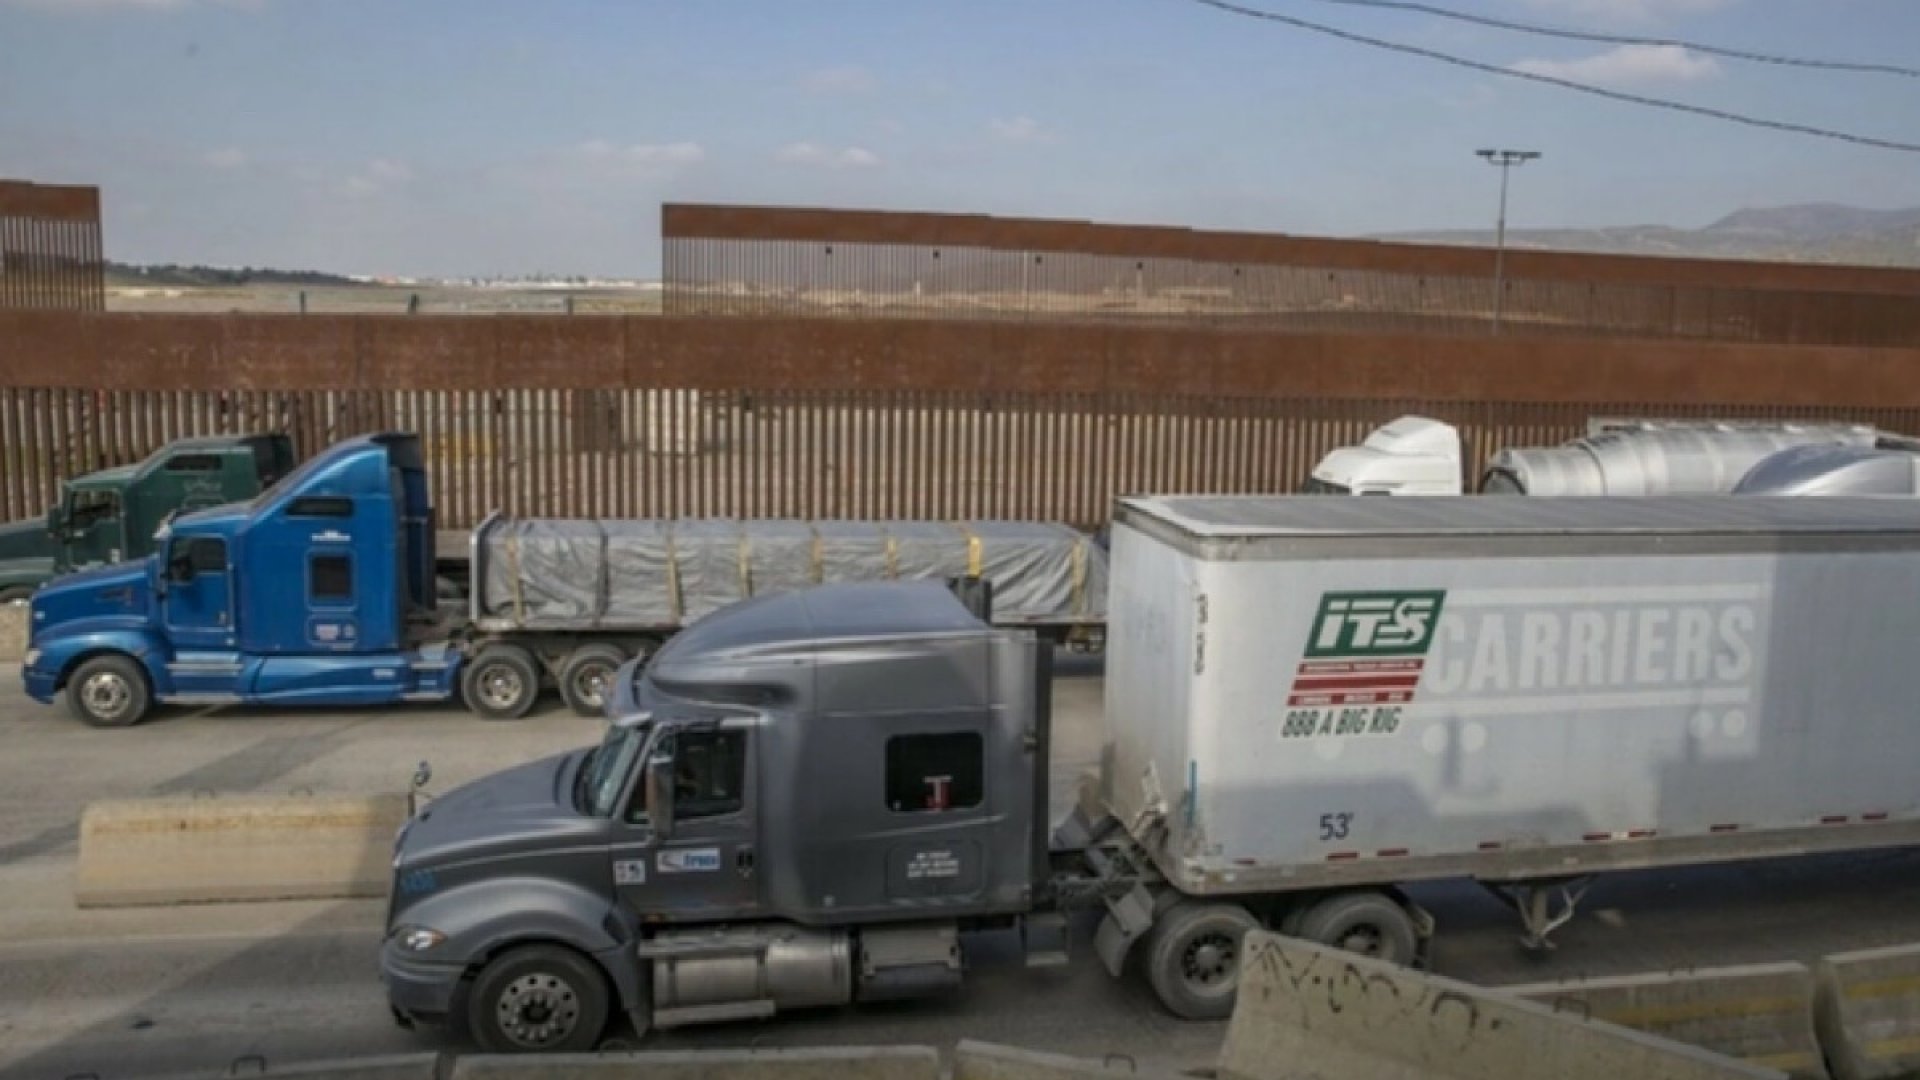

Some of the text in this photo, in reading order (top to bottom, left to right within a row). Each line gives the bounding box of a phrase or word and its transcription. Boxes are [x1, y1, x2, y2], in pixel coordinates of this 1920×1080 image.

[1431, 604, 1753, 694] CARRIERS
[1319, 710, 1334, 734] A
[1336, 708, 1369, 735] BIG
[1368, 706, 1403, 734] RIG
